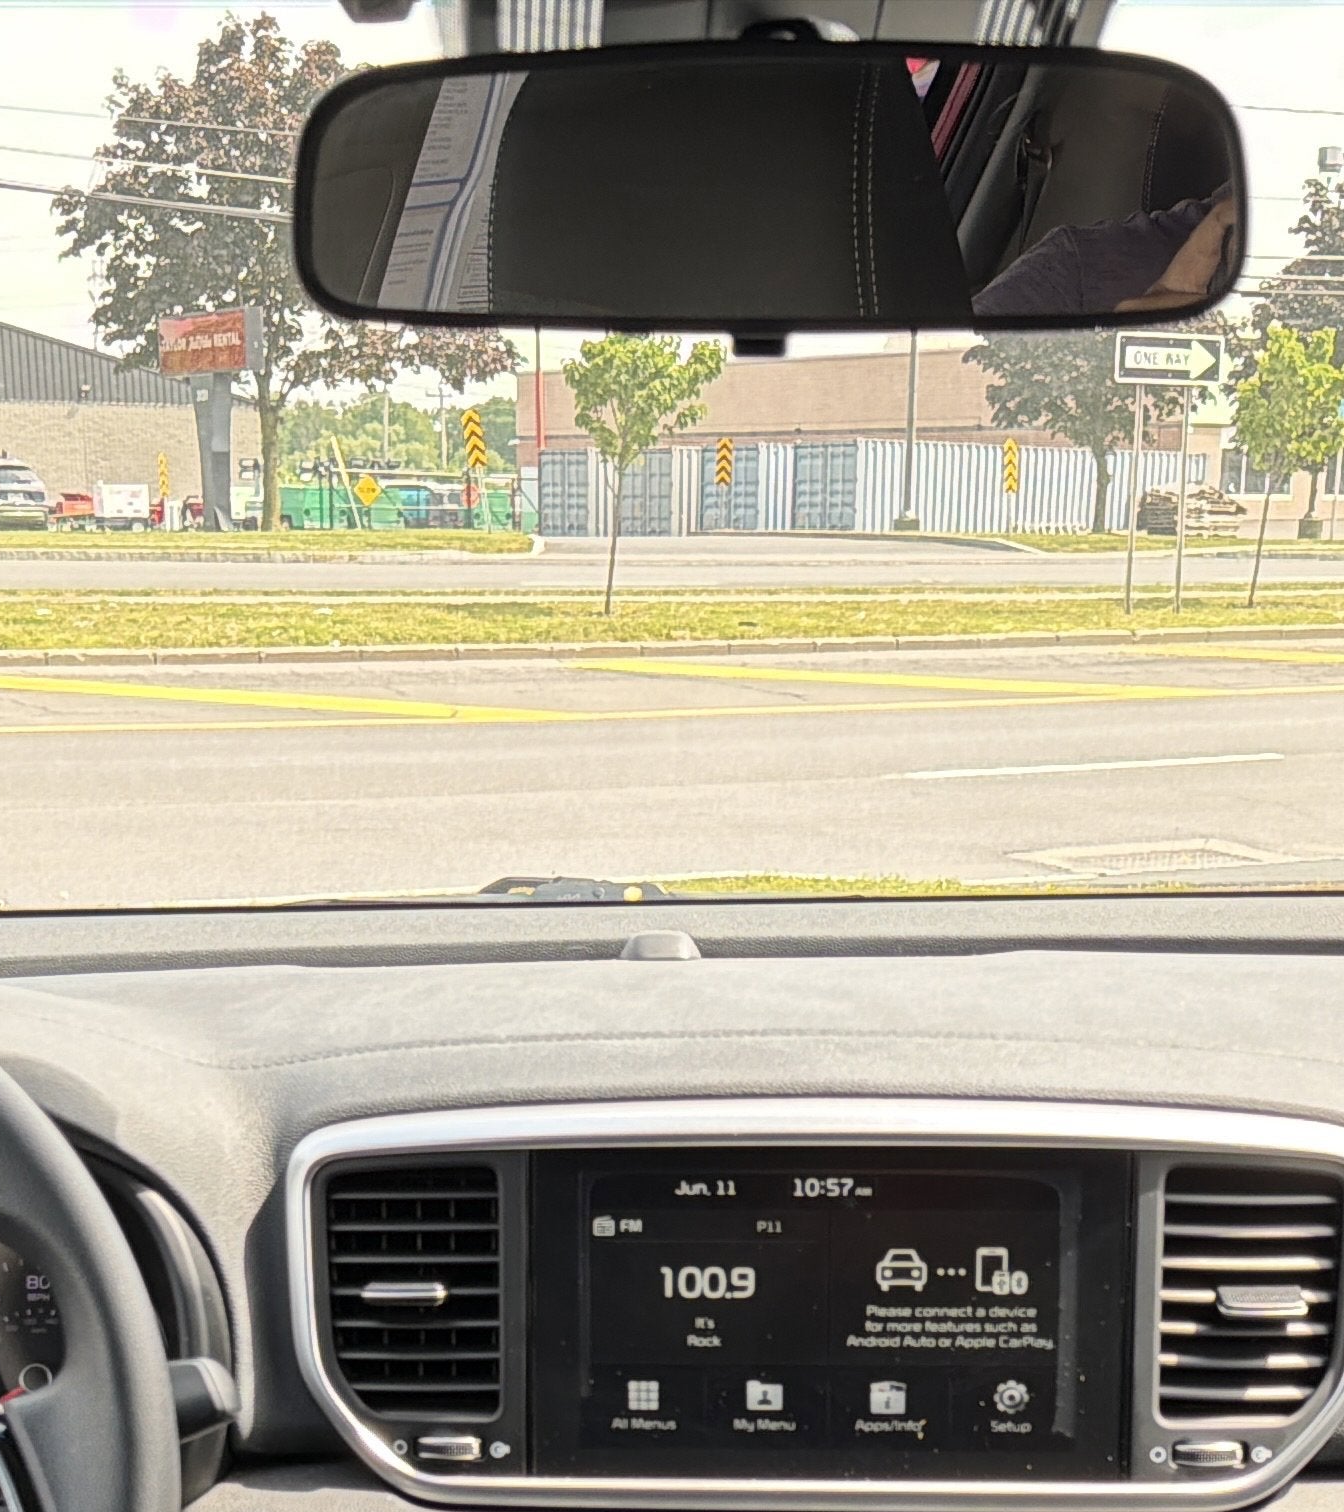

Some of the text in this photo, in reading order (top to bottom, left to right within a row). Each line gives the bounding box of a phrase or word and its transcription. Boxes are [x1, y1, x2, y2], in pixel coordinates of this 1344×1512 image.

[1133, 350, 1190, 366] ONE WAY
[674, 1179, 737, 1197] Jun. 11
[793, 1177, 854, 1198] 10:57
[619, 1218, 644, 1233] FM
[756, 1220, 783, 1234] P11
[25, 1275, 51, 1290] 80
[659, 1265, 757, 1300] 100.9
[866, 1305, 1038, 1318] Please connect a device
[694, 1316, 716, 1330] It's
[864, 1320, 1038, 1333] for more features such as
[686, 1334, 723, 1348] Rock
[846, 1334, 901, 1348] Android
[902, 1335, 937, 1348] Auto
[938, 1338, 953, 1348] or
[955, 1335, 997, 1349] Apple
[610, 1417, 677, 1431] All Menus
[732, 1418, 797, 1433] My Menu
[855, 1419, 924, 1433] Apps/Info
[989, 1419, 1033, 1433] Setup
